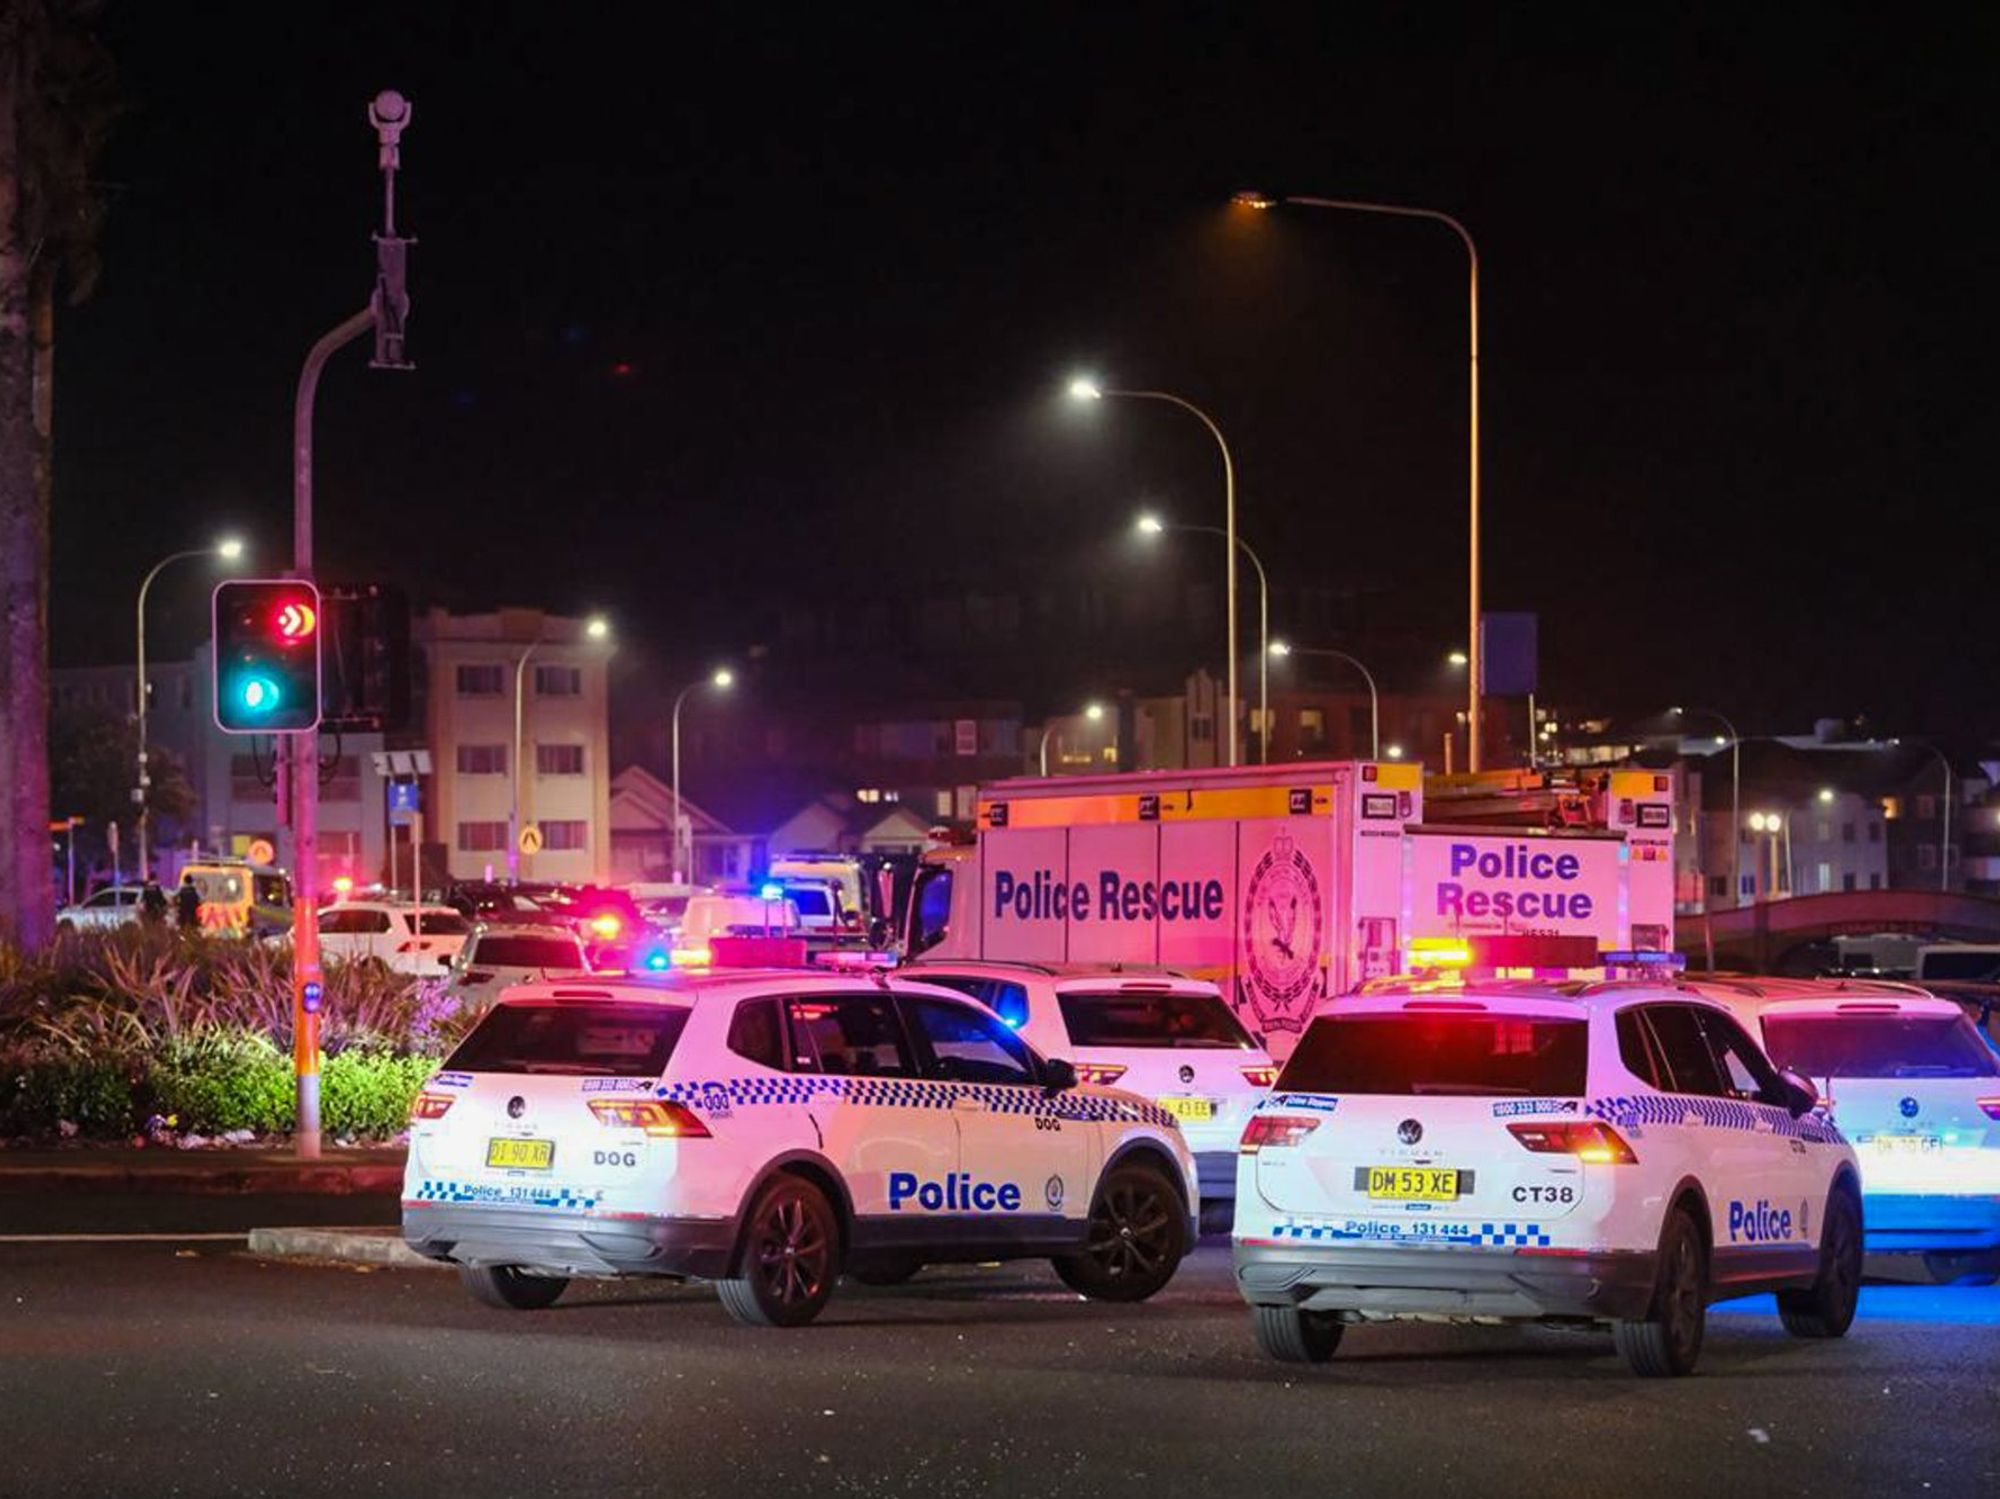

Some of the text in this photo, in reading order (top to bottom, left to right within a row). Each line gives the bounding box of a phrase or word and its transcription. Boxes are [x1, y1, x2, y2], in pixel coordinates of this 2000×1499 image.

[1451, 844, 1580, 880] Police
[995, 870, 1224, 921] Police Rescue
[1436, 883, 1593, 919] Rescue
[593, 1151, 636, 1167] DOG
[464, 1184, 501, 1196] Police
[890, 1172, 1020, 1210] Police
[1372, 1171, 1454, 1194] DM 53 XE
[1512, 1187, 1573, 1203] CT38
[1346, 1220, 1401, 1234] Police
[1730, 1200, 1792, 1241] Police
